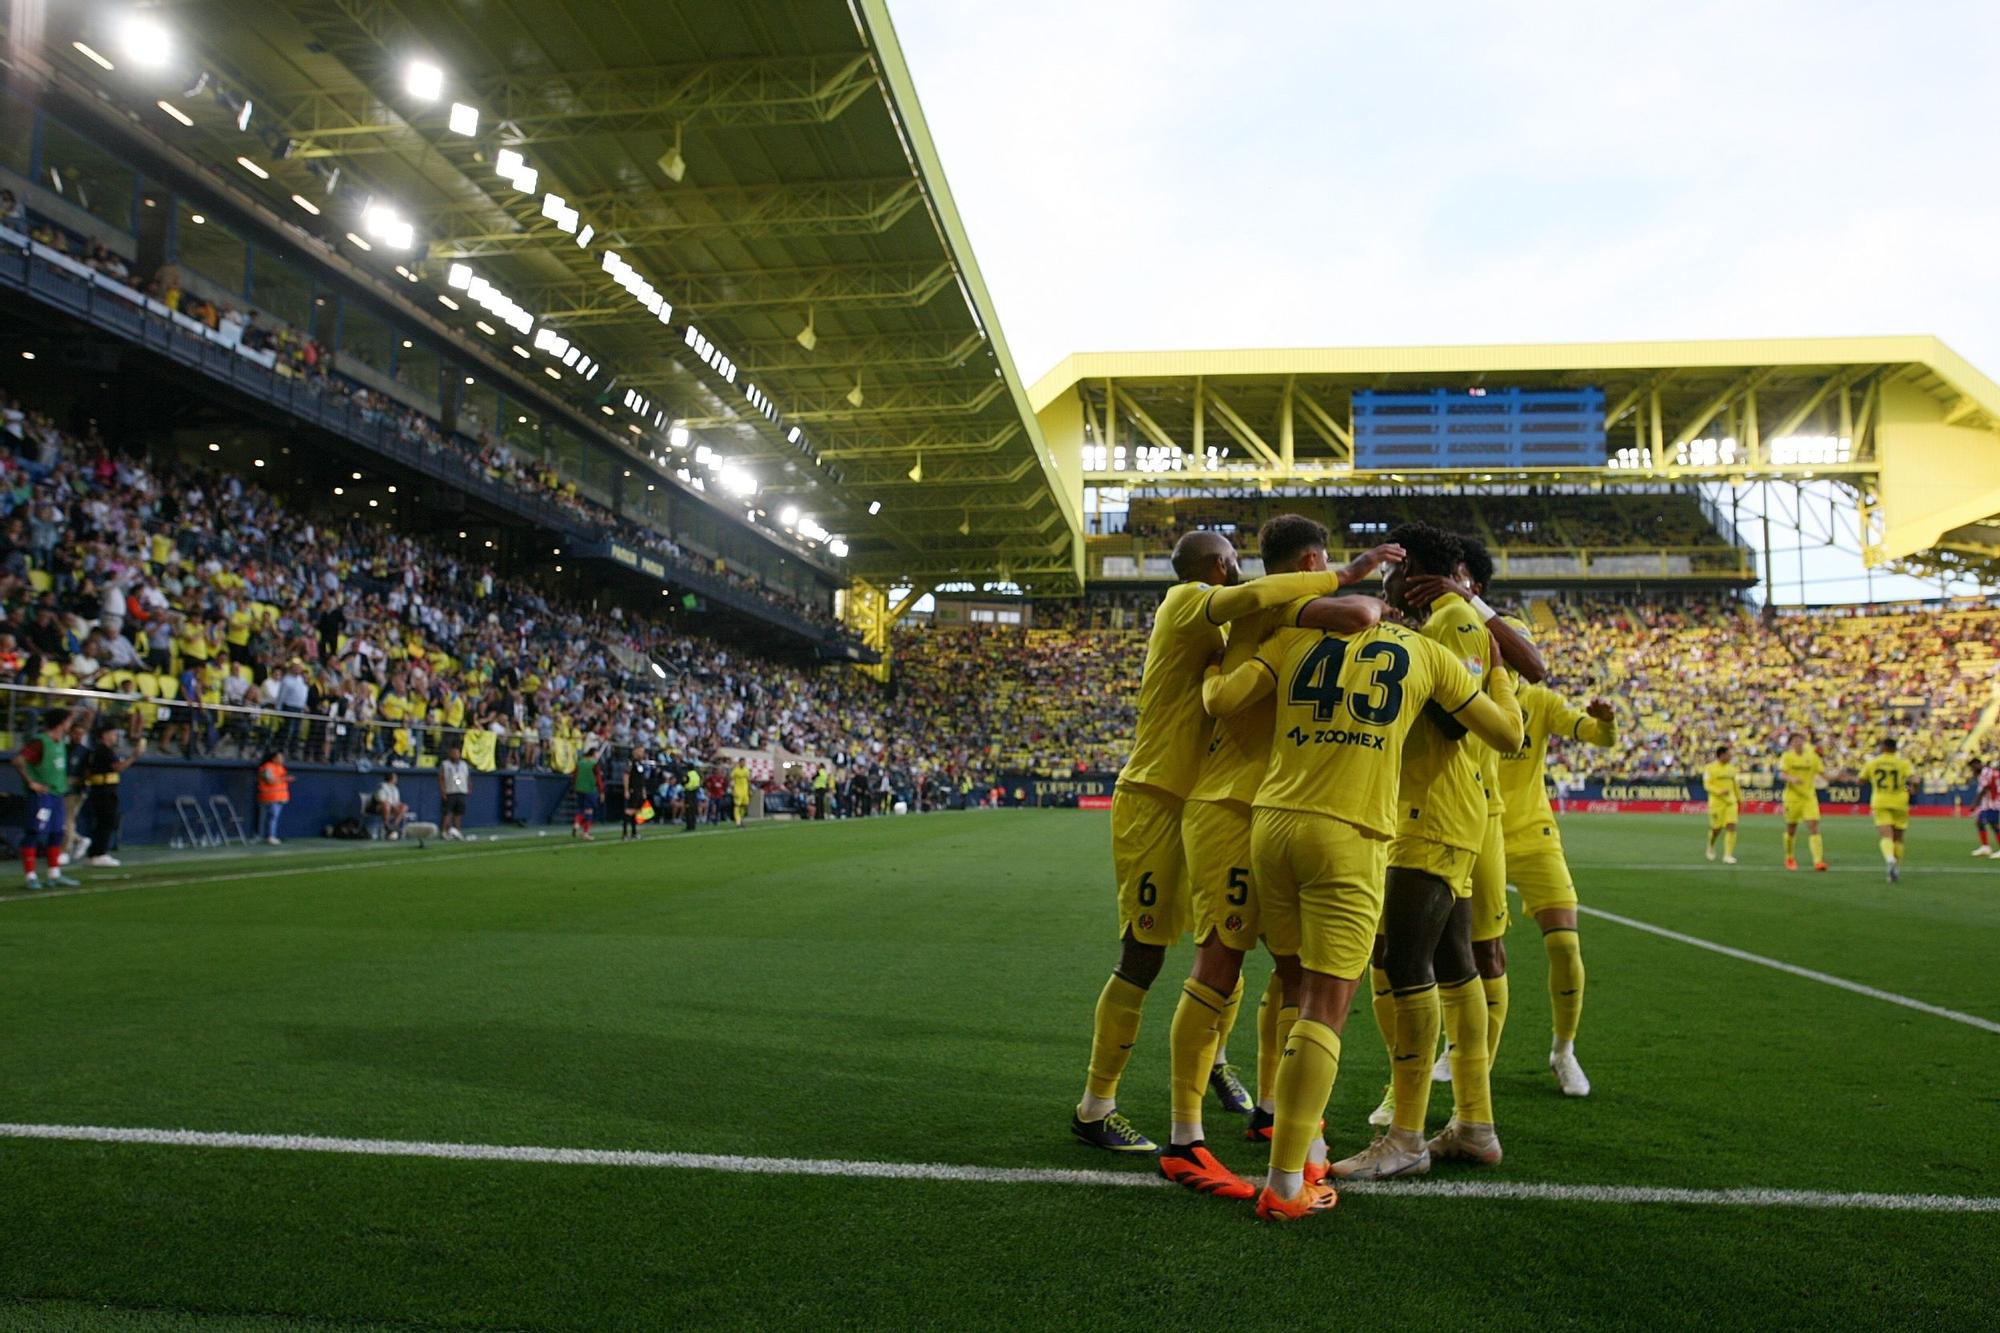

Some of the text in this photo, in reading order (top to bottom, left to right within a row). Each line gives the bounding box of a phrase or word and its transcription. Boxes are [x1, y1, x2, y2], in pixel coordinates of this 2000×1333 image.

[1288, 636, 1410, 727] 43
[1314, 729, 1386, 751] ZOOMEX
[1874, 768, 1899, 790] 21
[1138, 870, 1157, 907] 6
[1226, 866, 1250, 906] 5
